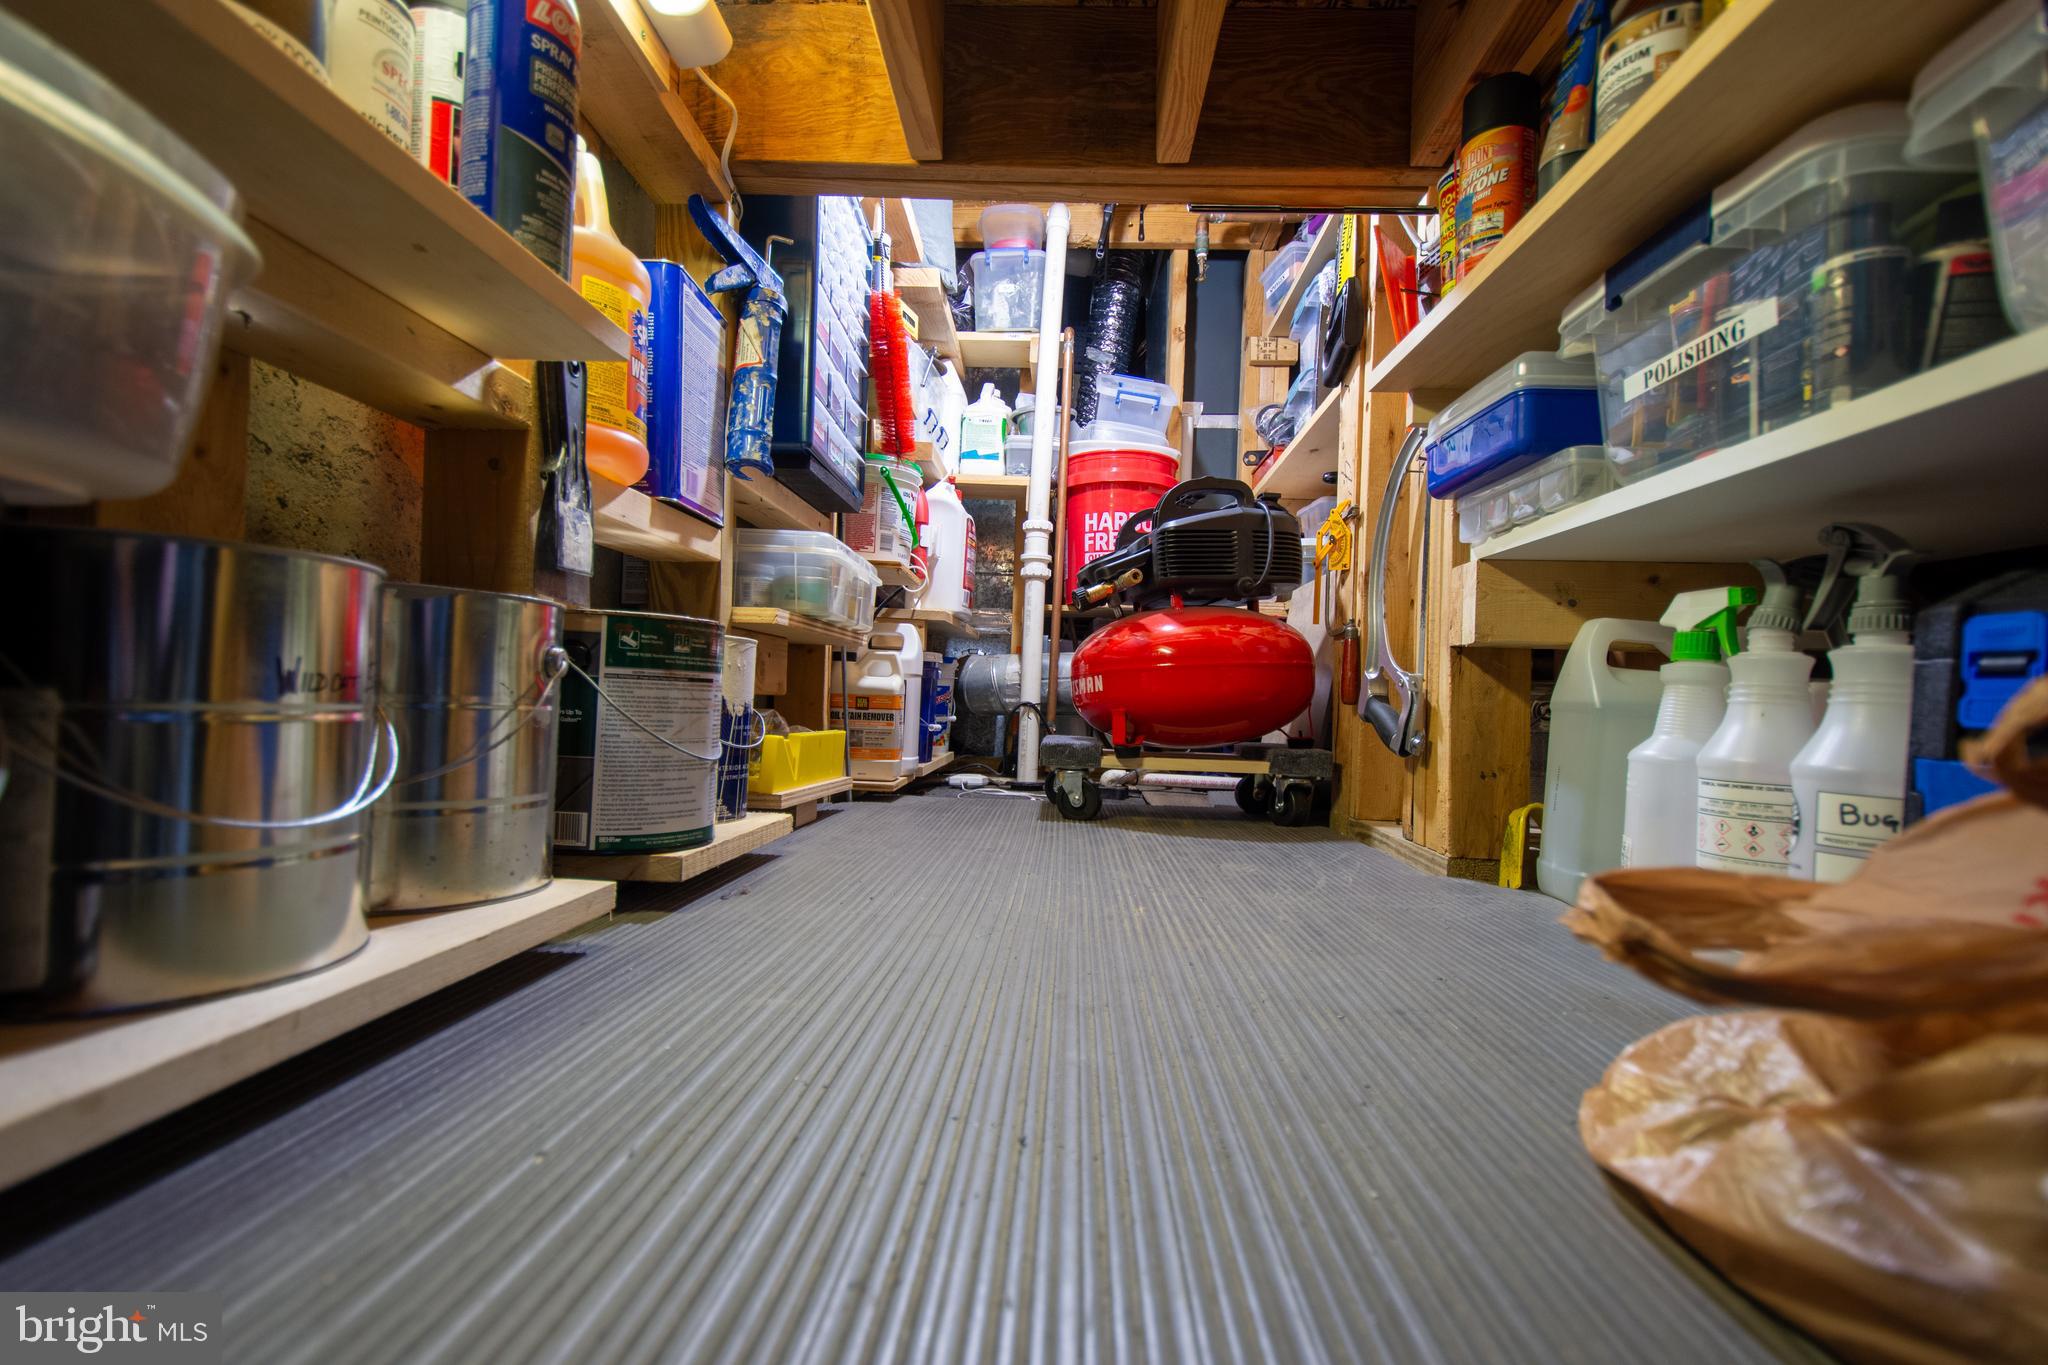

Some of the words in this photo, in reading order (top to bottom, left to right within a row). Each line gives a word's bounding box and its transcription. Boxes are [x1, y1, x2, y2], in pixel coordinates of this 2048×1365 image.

[530, 33, 572, 70] SPRAY
[1643, 319, 1745, 389] POLISHING
[862, 712, 895, 722] REMOVER
